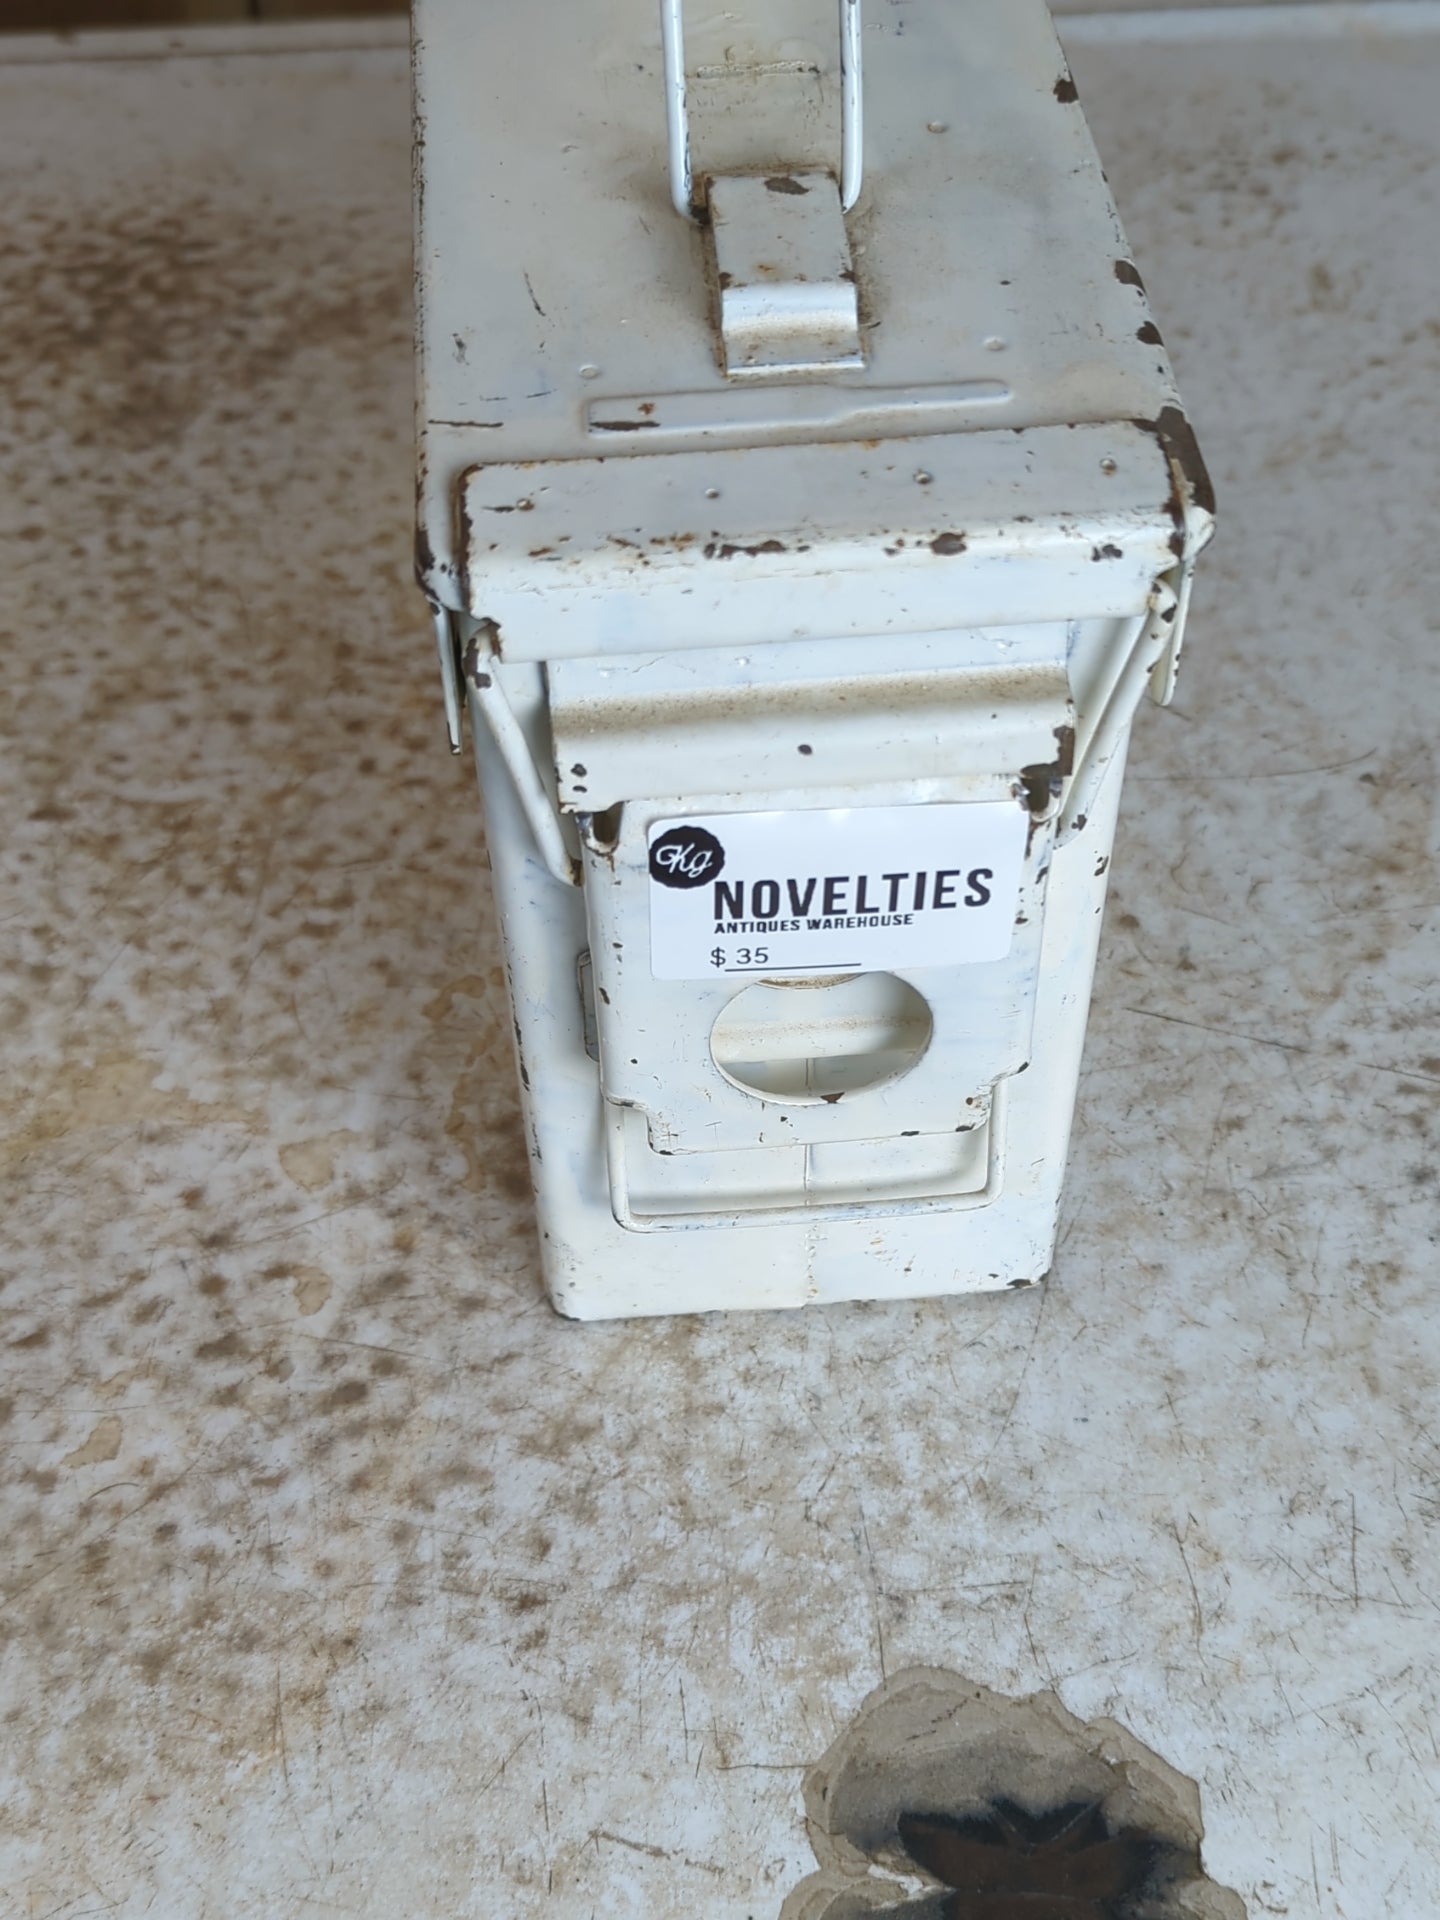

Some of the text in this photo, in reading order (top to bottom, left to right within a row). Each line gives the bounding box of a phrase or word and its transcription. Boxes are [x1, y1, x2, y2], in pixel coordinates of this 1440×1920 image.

[656, 843, 713, 878] Kg
[714, 868, 993, 920] NOVELTIES
[714, 913, 914, 934] ANTIQUES WAREHOUSE
[710, 947, 769, 968] $ 35
